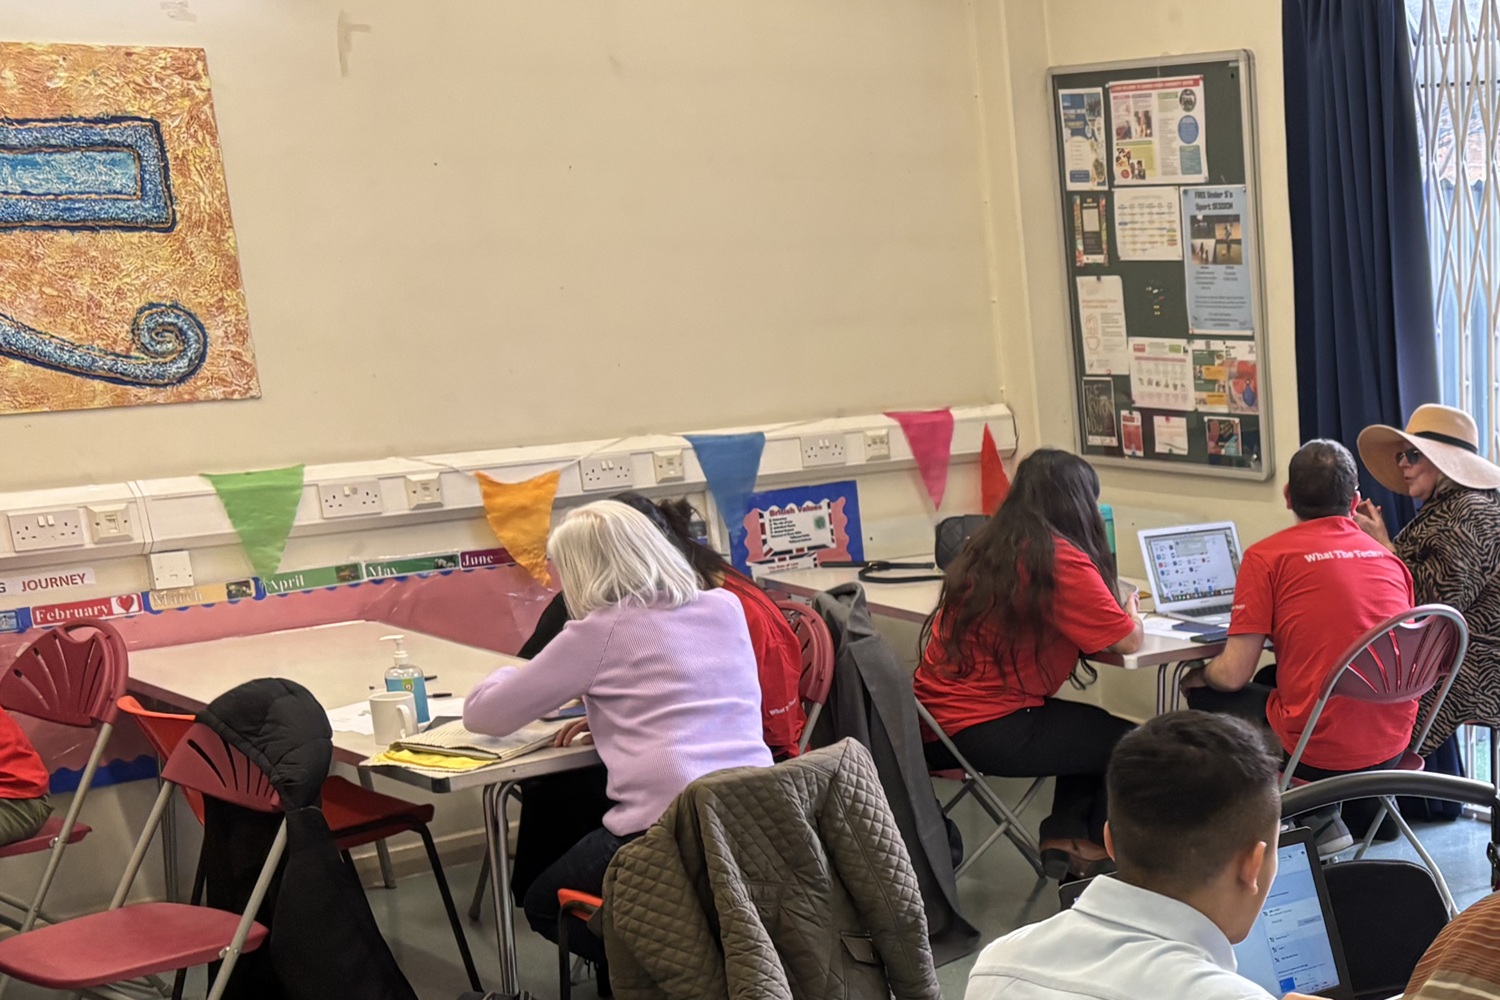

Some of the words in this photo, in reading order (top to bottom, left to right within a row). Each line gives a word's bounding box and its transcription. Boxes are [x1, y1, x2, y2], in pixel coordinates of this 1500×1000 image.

[769, 508, 795, 516] British
[798, 505, 822, 513] Values
[462, 554, 494, 567] June
[1304, 551, 1334, 563] What
[1334, 550, 1354, 559] The
[369, 565, 399, 577] May
[21, 573, 86, 592] JOURNEY
[268, 574, 305, 593] April
[152, 591, 203, 607] March
[35, 602, 110, 623] February
